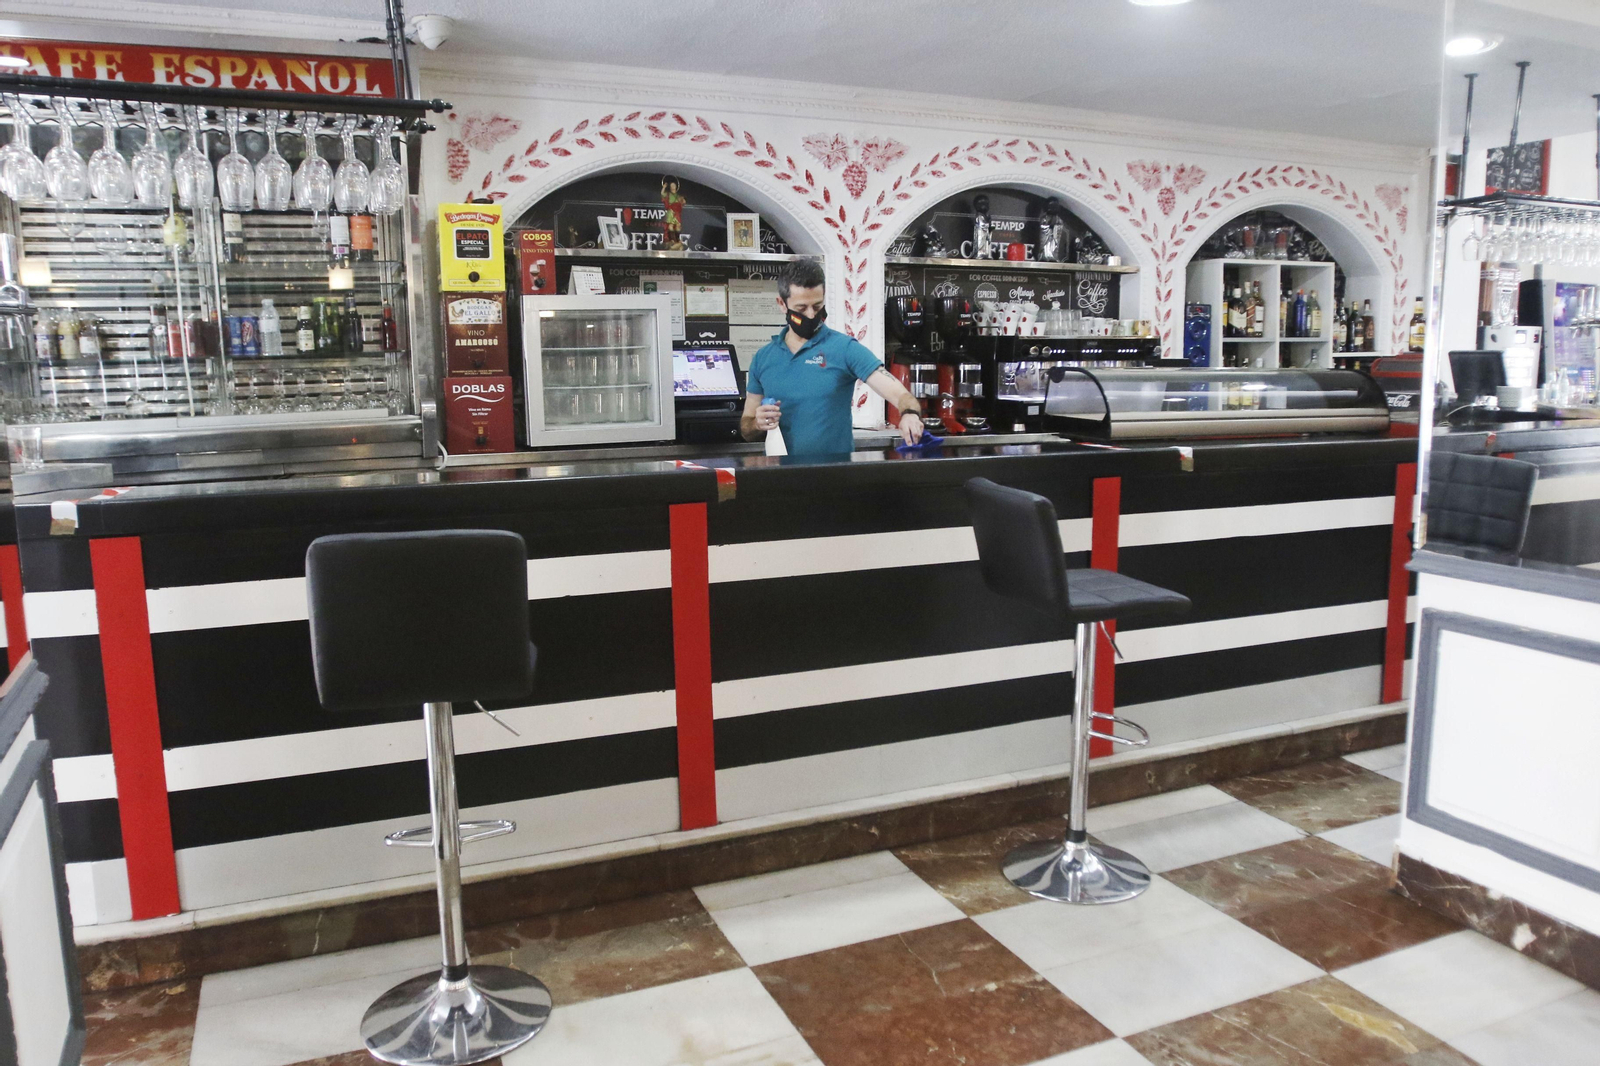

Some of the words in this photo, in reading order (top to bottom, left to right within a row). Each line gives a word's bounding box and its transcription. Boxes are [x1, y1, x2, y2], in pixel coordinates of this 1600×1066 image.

[0, 45, 125, 81] AFE
[150, 52, 383, 95] ESPAÑOL
[632, 208, 668, 220] TEMP
[467, 232, 488, 240] PATO
[523, 233, 552, 241] COBOS
[1077, 278, 1108, 303] Coffee
[452, 383, 505, 394] DOBLAS
